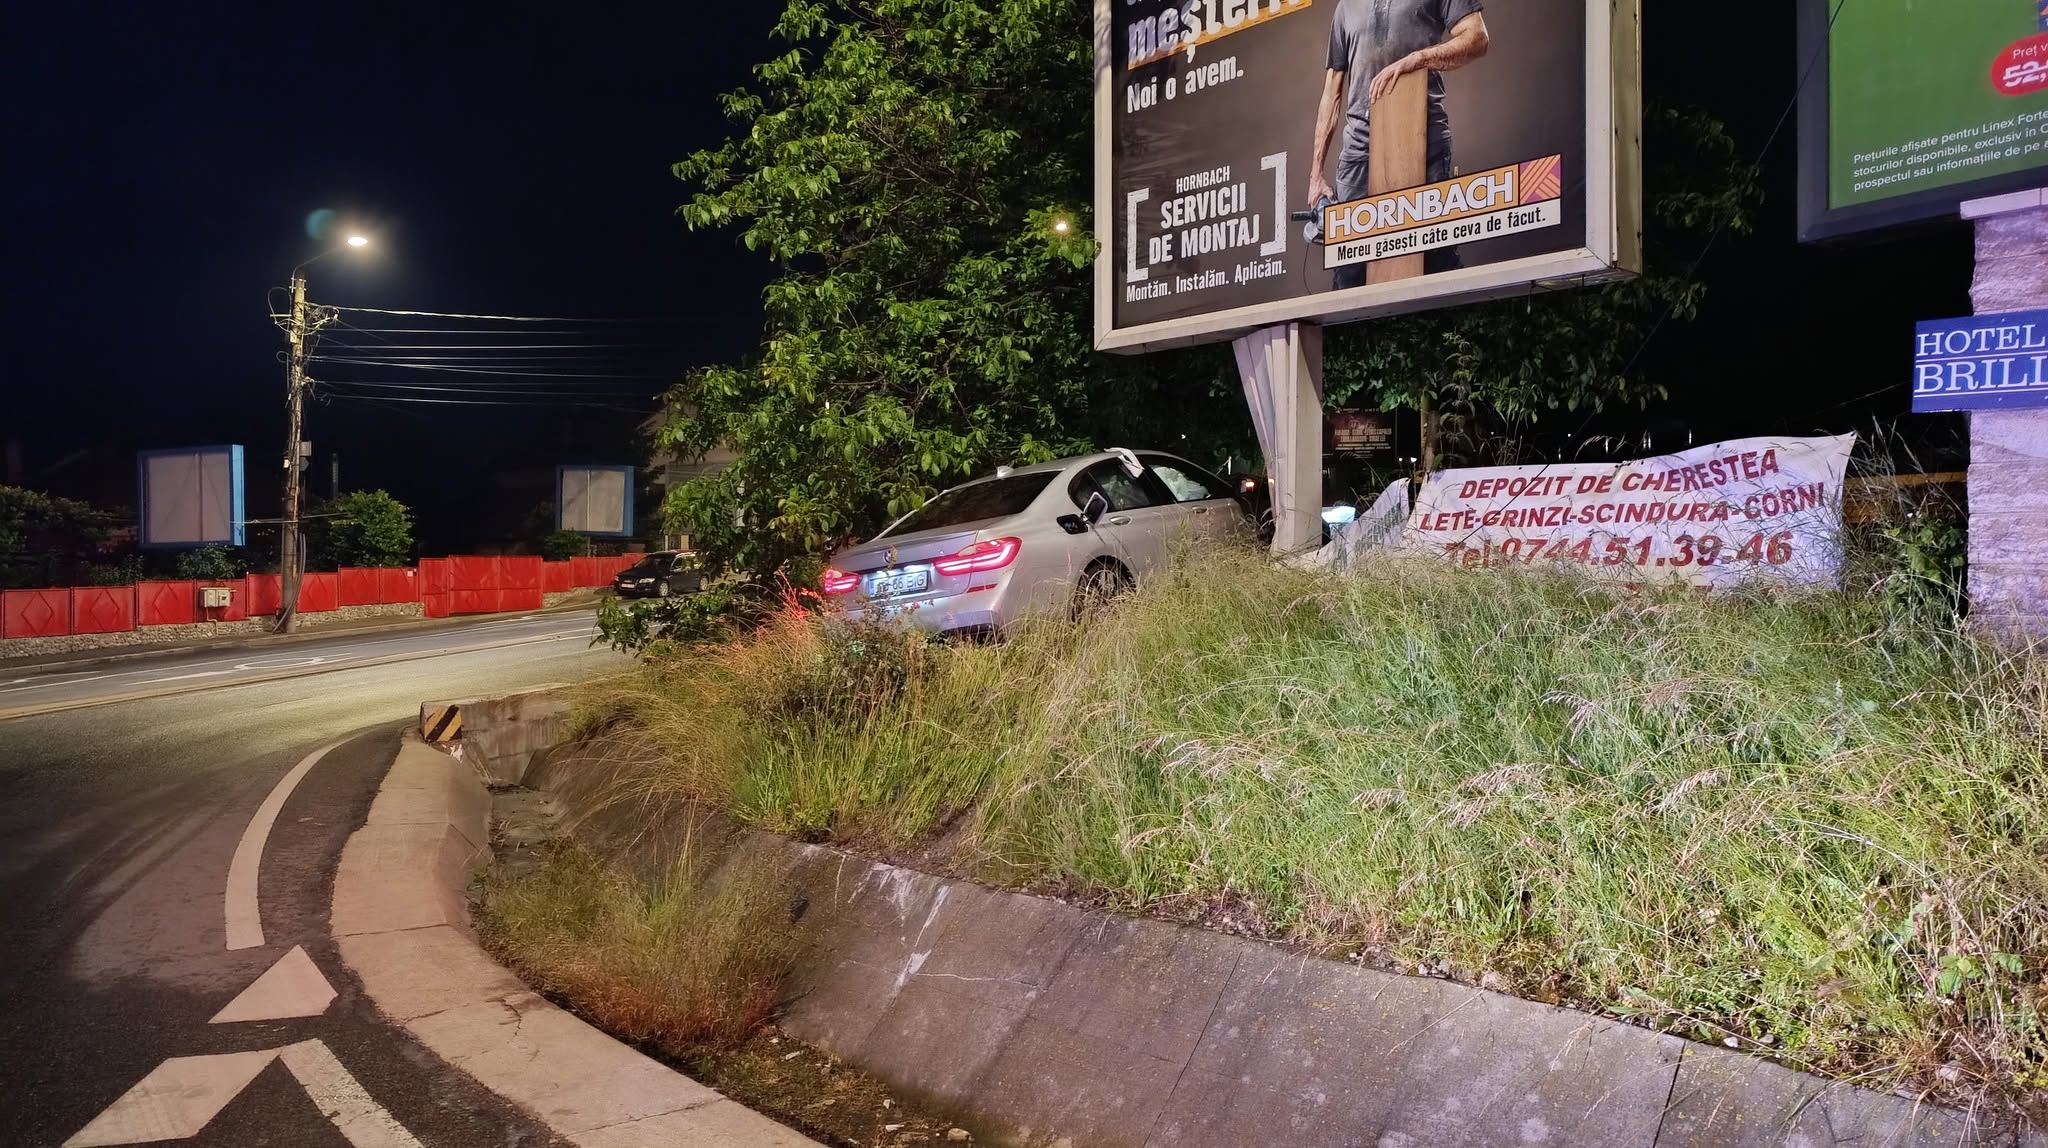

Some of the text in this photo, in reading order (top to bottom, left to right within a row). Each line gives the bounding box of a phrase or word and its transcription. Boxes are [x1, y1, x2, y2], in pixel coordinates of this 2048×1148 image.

[2012, 45, 2037, 60] Preț
[1127, 56, 1244, 113] Noi o avem.
[1853, 146, 1899, 165] Prețurile
[1901, 136, 1938, 153] afișate
[1941, 128, 1979, 145] pentru
[1982, 118, 2014, 133] Linex
[1853, 159, 1904, 178] stocurilor
[1906, 144, 1971, 165] disponibile,
[1974, 131, 2022, 150] exclusiv
[1176, 166, 1230, 193] HORNBACH
[1854, 171, 1911, 193] prospectul
[1913, 166, 1934, 178] sau
[1936, 151, 2001, 172] informațiile
[2004, 146, 2021, 157] de
[2024, 142, 2040, 155] pe
[1160, 182, 1247, 229] SERVICII
[1328, 170, 1514, 240] HORNBACH
[1149, 214, 1260, 265] DE MONTAJ
[1337, 206, 1547, 261] Mereu găsești câte ceva de făcut.
[1126, 257, 1287, 303] Montăm. Instalăm. Aplicăm.
[1915, 324, 2046, 357] HOTEL
[1459, 449, 1780, 499] DEPOZIT DE CHERESTEA
